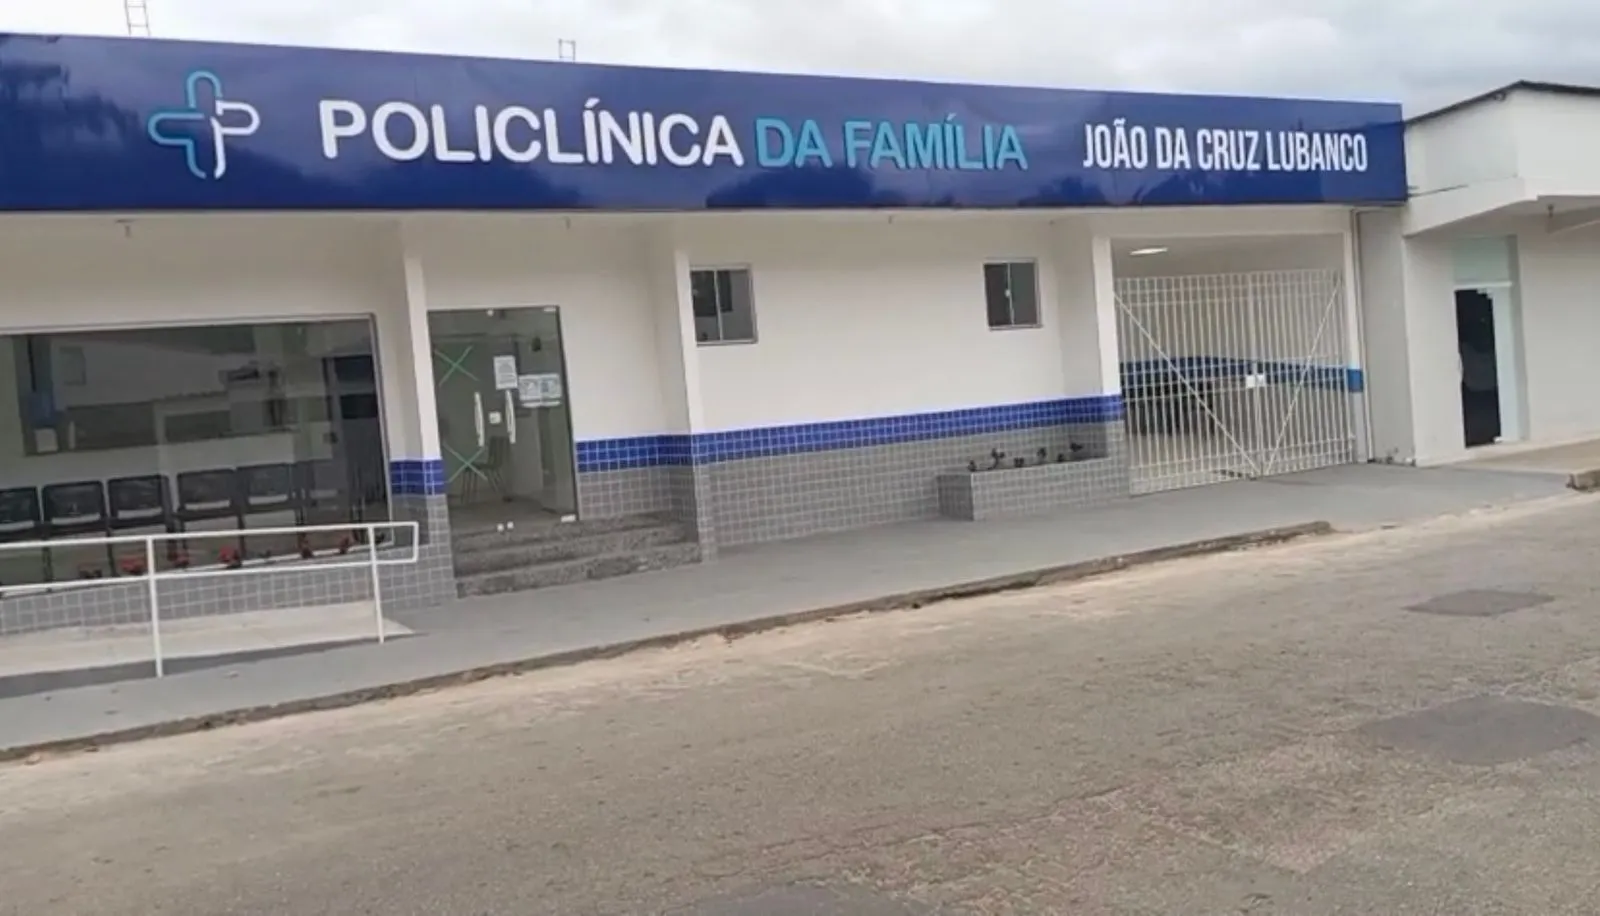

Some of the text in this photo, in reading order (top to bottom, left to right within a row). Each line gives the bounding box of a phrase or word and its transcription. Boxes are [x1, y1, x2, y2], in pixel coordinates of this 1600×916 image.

[319, 98, 1028, 171] POLICLÍNICA DA FAMÍLIA
[1082, 118, 1368, 173] JOÃO DA CRUZ LUBANCO
